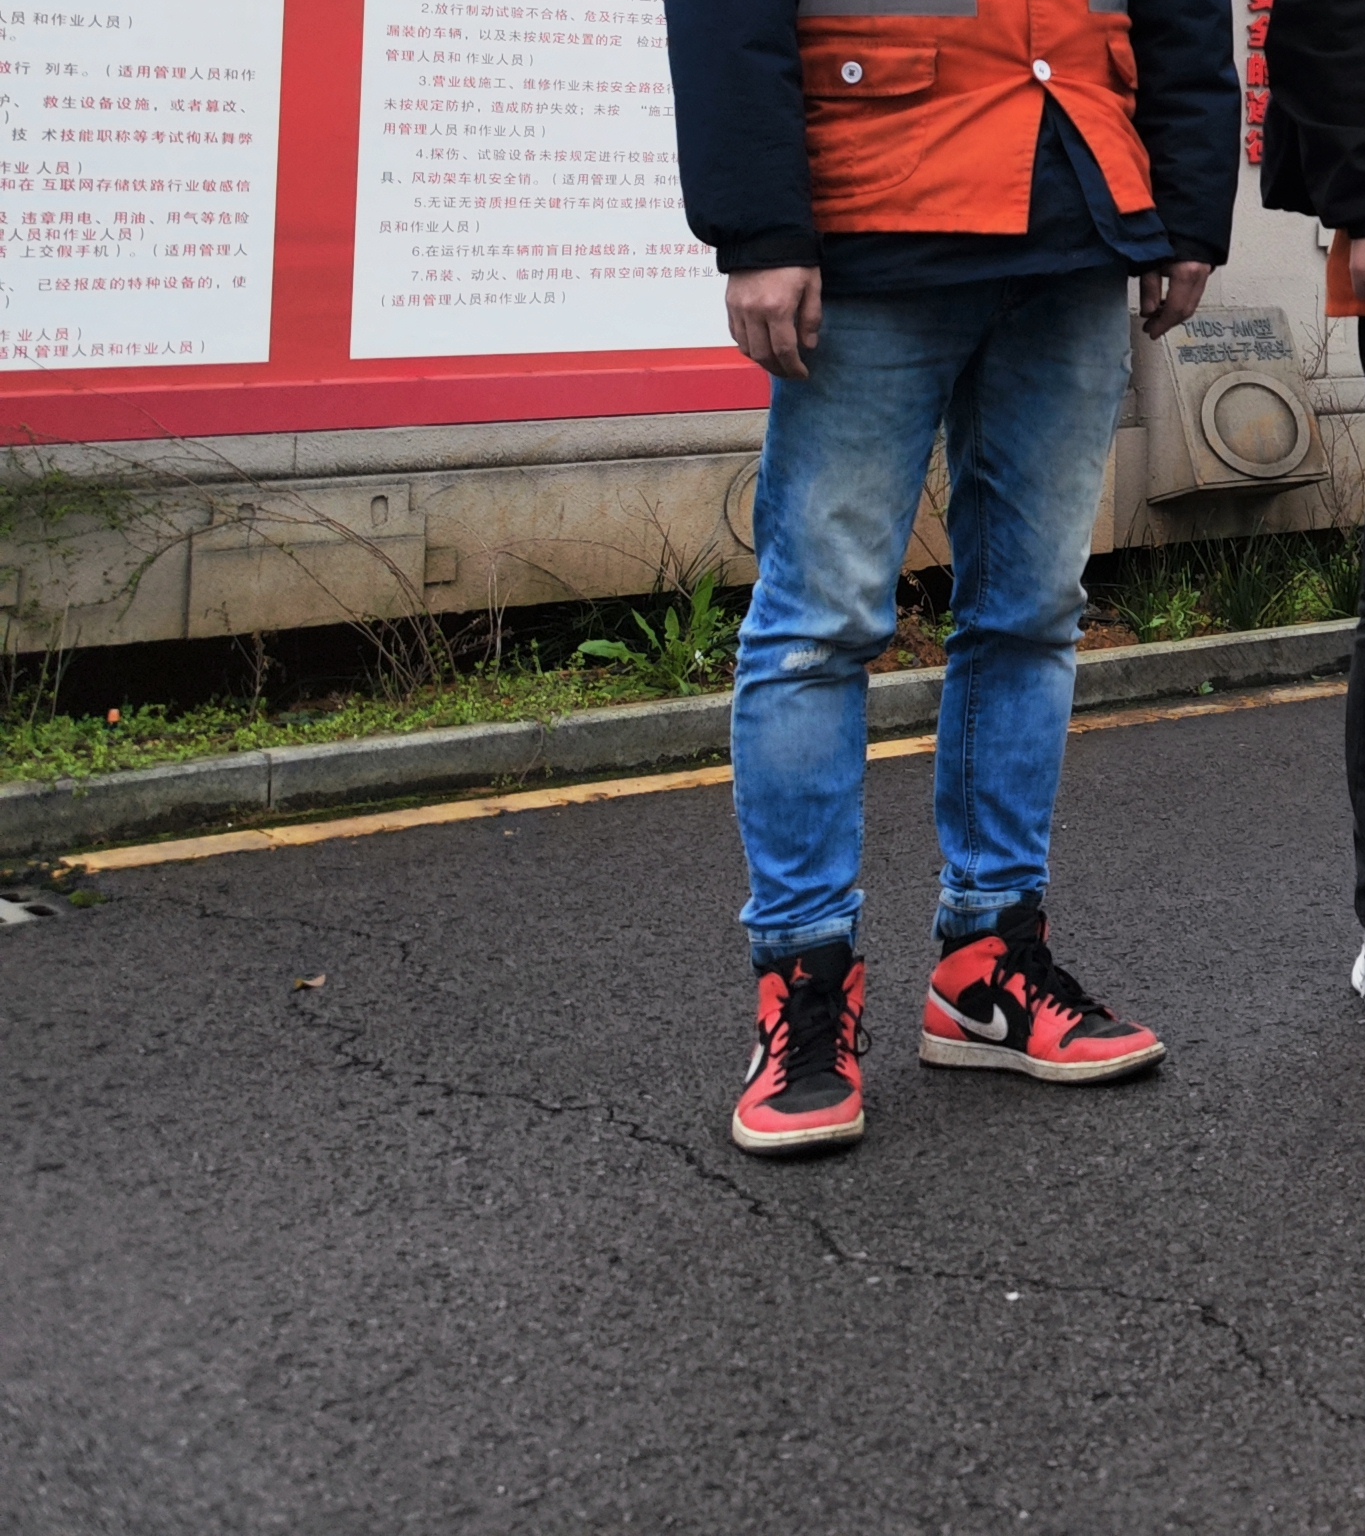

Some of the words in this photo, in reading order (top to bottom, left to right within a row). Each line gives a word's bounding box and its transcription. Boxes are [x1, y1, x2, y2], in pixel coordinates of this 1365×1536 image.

[412, 242, 718, 258] 6.在运行机车车辆前盲目抢越线路，违规穿越推
